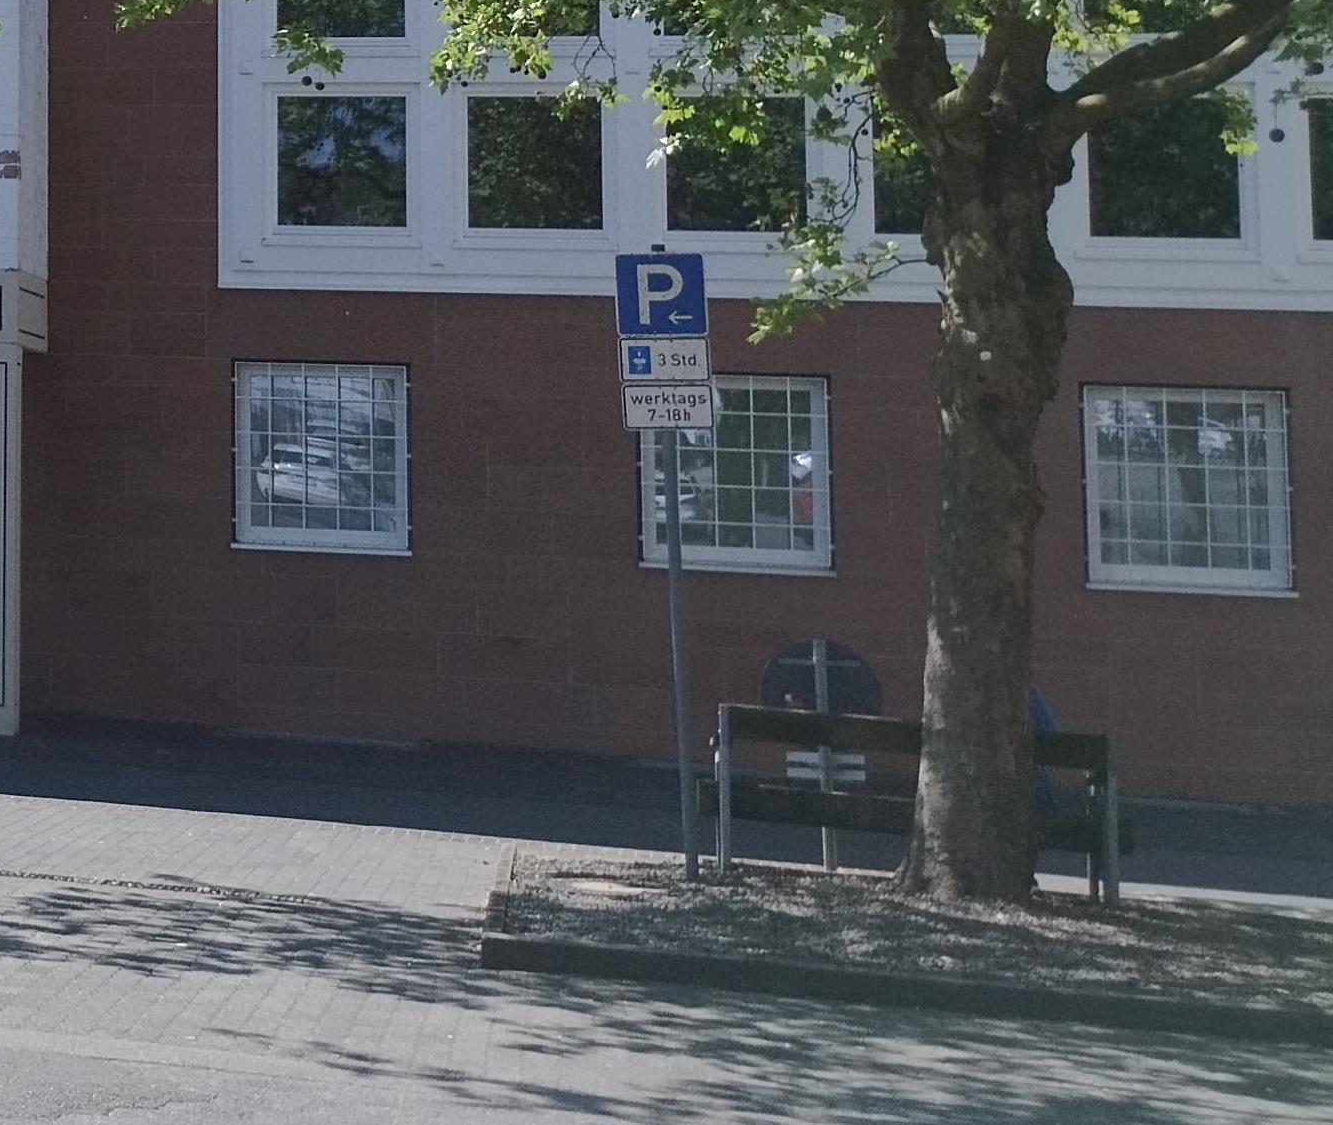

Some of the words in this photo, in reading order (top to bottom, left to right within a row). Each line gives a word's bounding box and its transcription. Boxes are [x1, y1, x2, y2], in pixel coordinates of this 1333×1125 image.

[636, 263, 684, 326] P
[658, 353, 666, 367] 3
[630, 391, 707, 408] werktags
